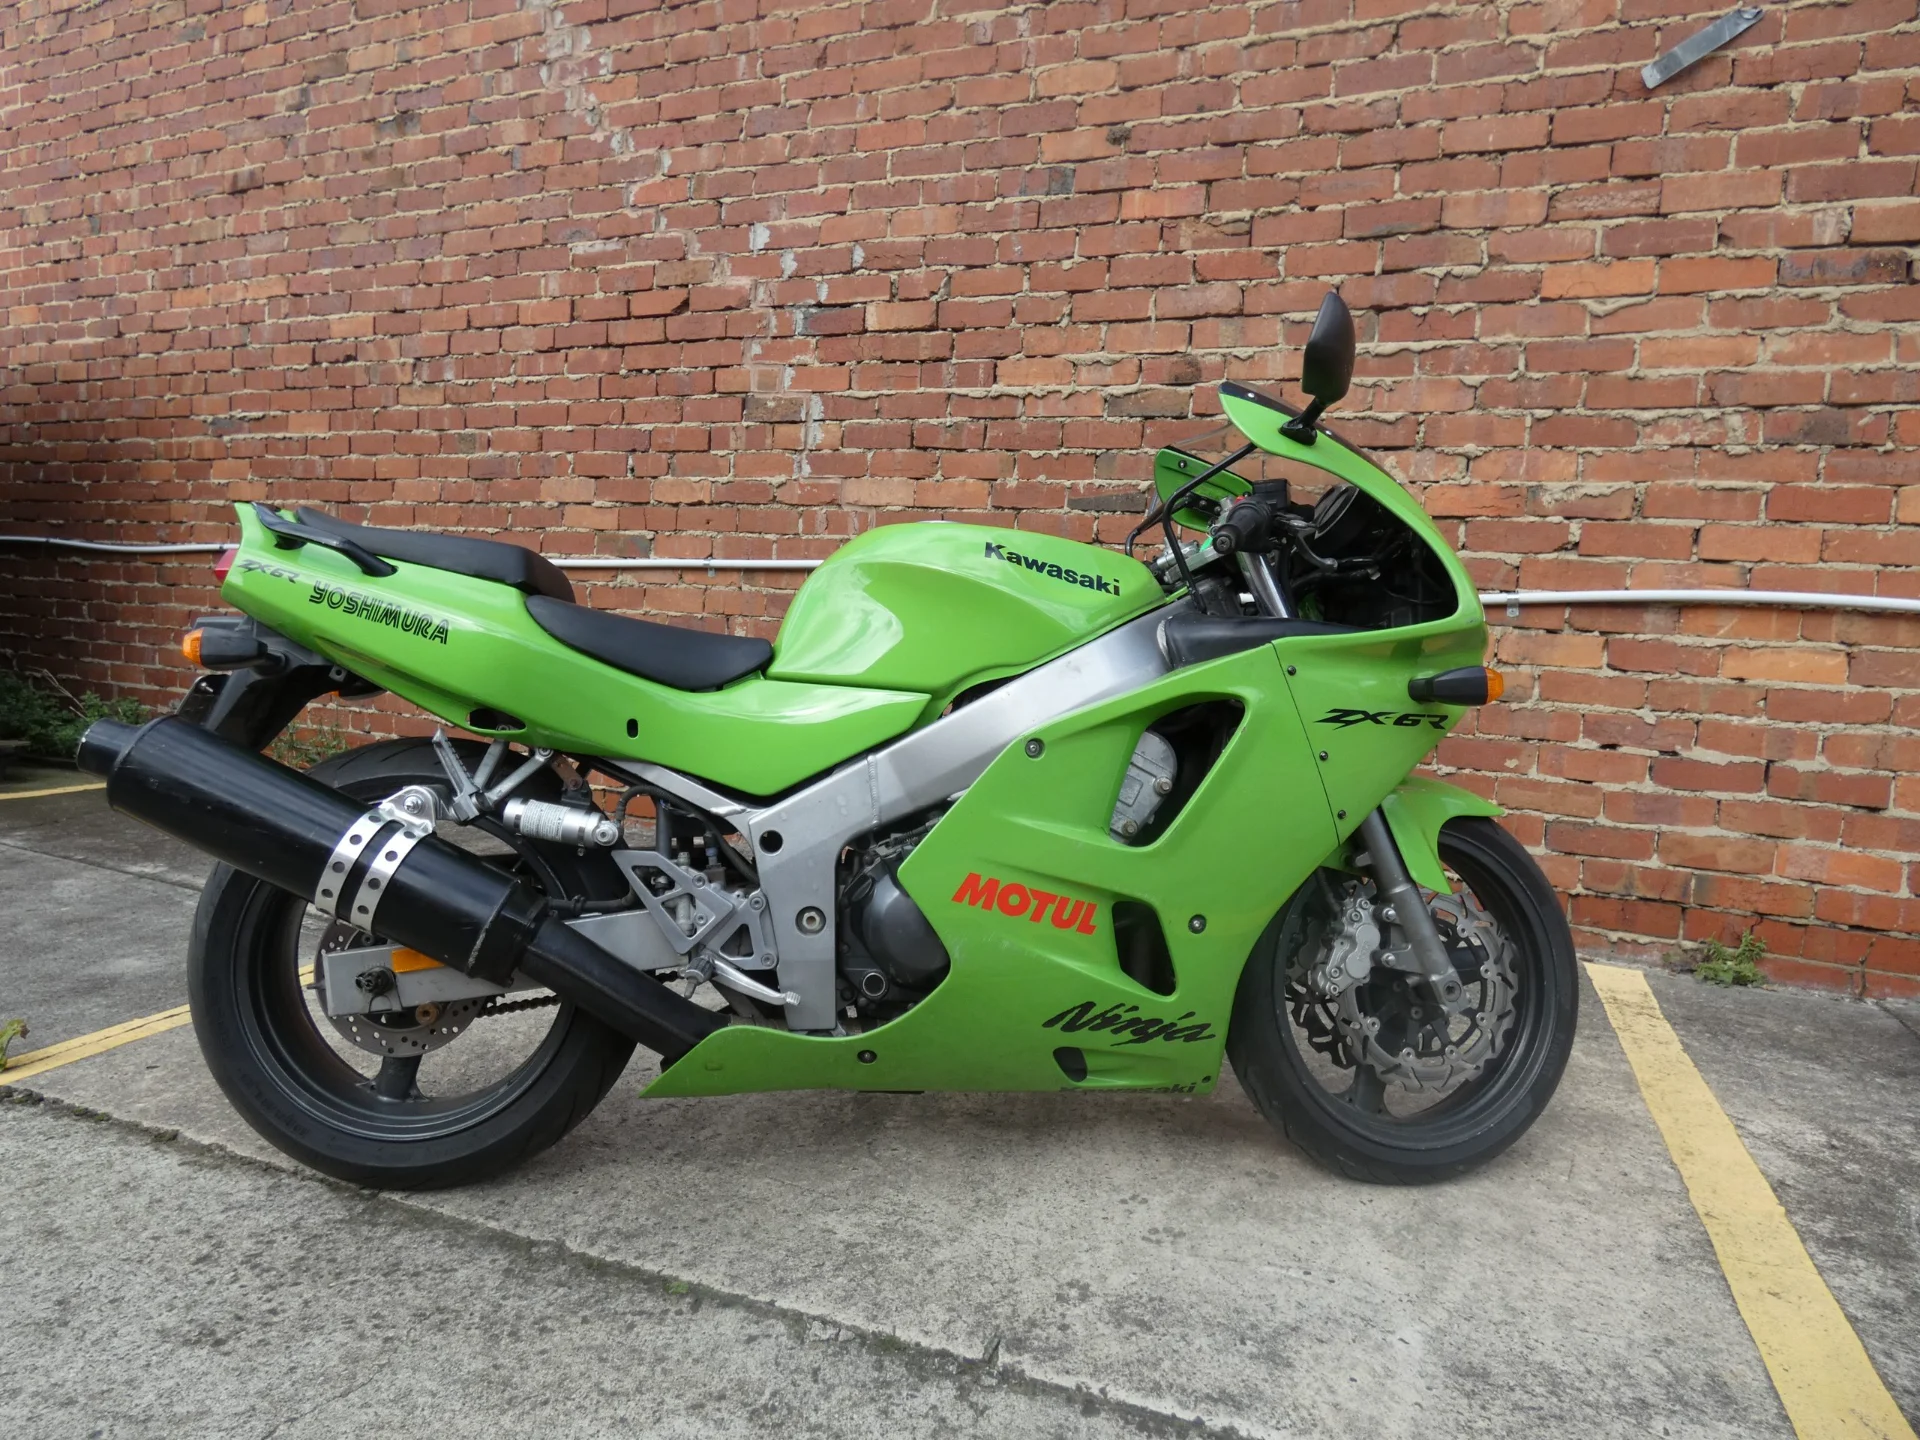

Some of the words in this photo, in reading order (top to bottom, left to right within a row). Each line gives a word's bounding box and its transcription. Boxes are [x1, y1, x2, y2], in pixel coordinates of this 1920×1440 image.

[984, 541, 1121, 597] Kawasaki
[308, 579, 450, 645] YOSHIMURA
[951, 871, 1098, 936] MOTUL
[1041, 1001, 1217, 1047] Ninja
